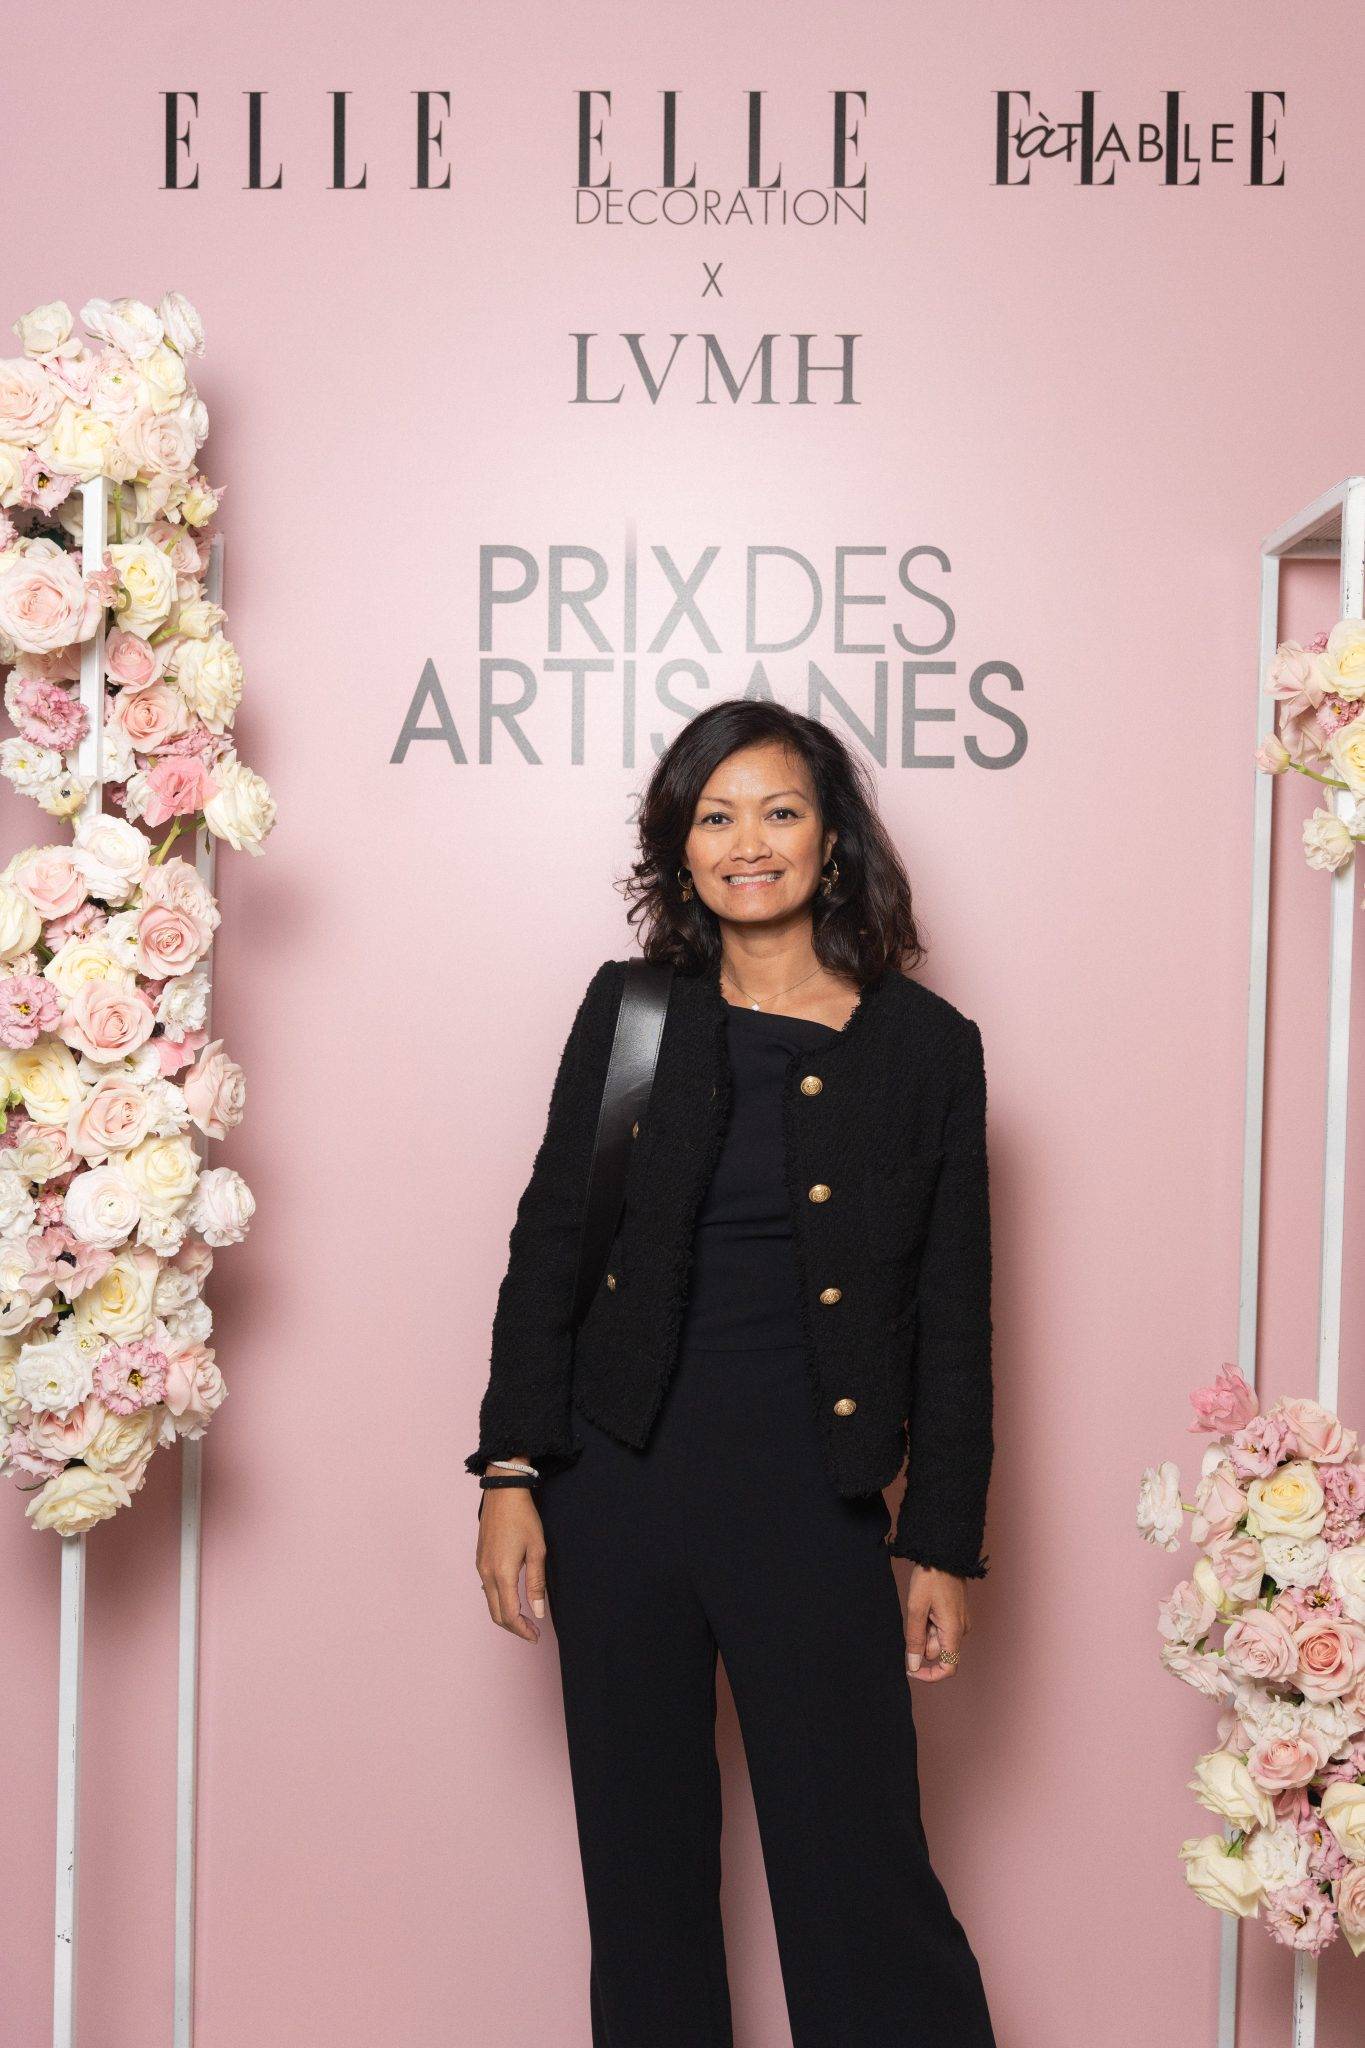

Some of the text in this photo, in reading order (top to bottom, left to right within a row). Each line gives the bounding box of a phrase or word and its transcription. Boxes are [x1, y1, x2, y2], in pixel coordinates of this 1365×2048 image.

[158, 91, 452, 190] ELLE
[572, 90, 868, 189] ELLE
[989, 90, 1286, 187] ELLE
[575, 189, 868, 226] DECORATION
[567, 332, 863, 406] LVMH
[478, 520, 956, 656] PRIX DES
